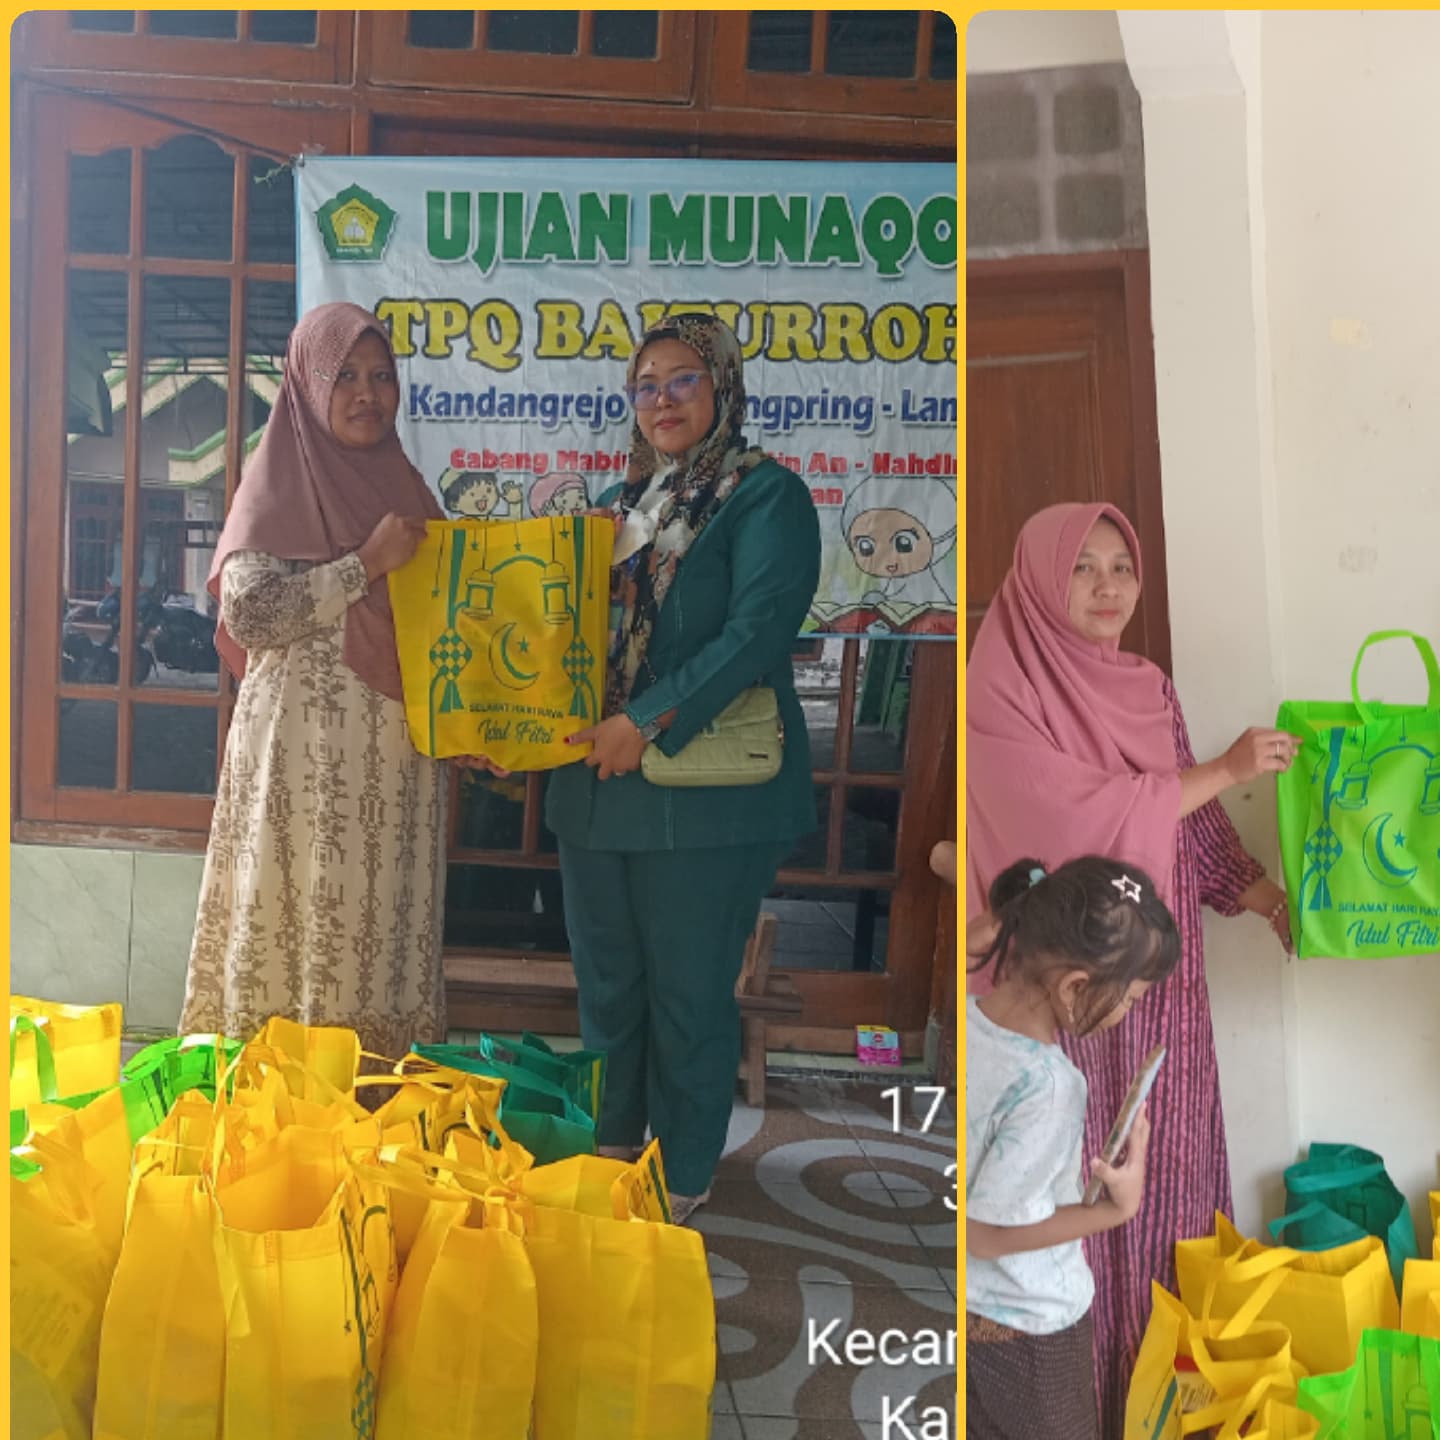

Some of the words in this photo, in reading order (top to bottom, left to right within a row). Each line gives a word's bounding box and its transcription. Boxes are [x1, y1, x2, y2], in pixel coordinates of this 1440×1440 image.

[426, 191, 630, 275] UJIAN
[376, 298, 523, 372] TPQ
[409, 383, 627, 431] Kandangrejo
[744, 388, 874, 431] ngpring
[450, 448, 549, 474] Cabang
[556, 449, 628, 471] Mabi
[807, 452, 848, 474] An
[1338, 902, 1388, 913] SELAMAT
[1346, 920, 1391, 948] Idul
[1396, 919, 1440, 948] Fitri
